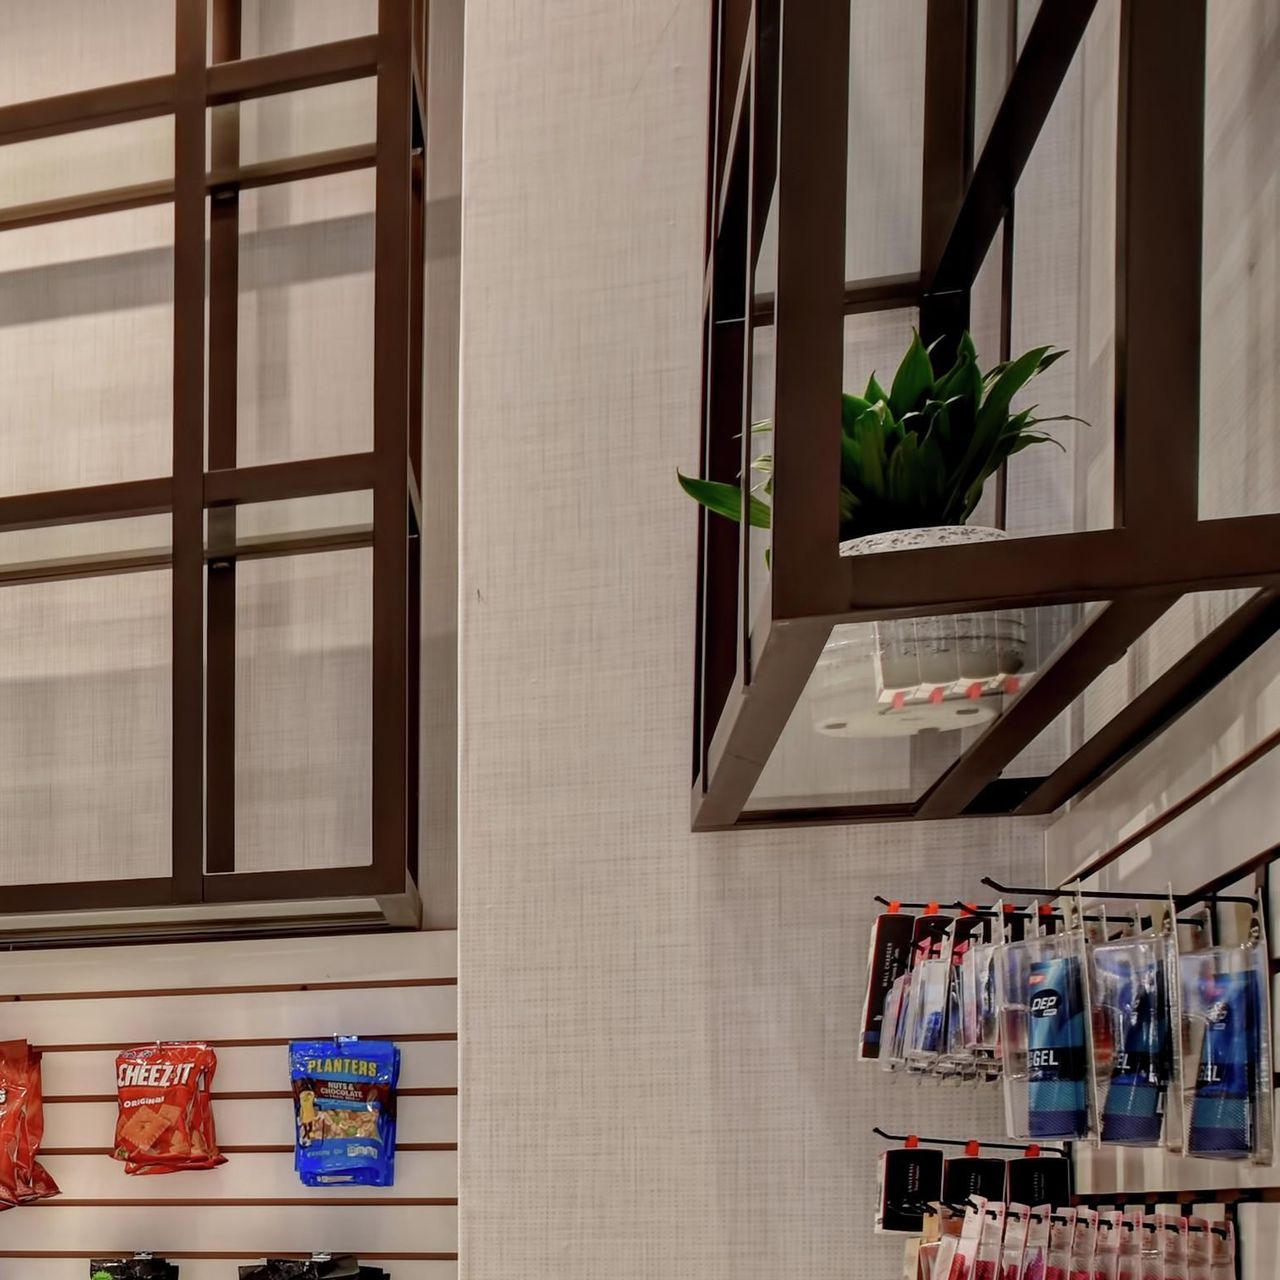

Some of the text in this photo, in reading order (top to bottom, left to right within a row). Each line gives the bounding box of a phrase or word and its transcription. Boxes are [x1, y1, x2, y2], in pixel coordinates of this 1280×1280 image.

[1031, 996, 1057, 1011] DEP
[308, 1058, 377, 1077] PLANTERS
[328, 1081, 346, 1090] NUTS
[320, 1087, 363, 1098] CHOCOLATE
